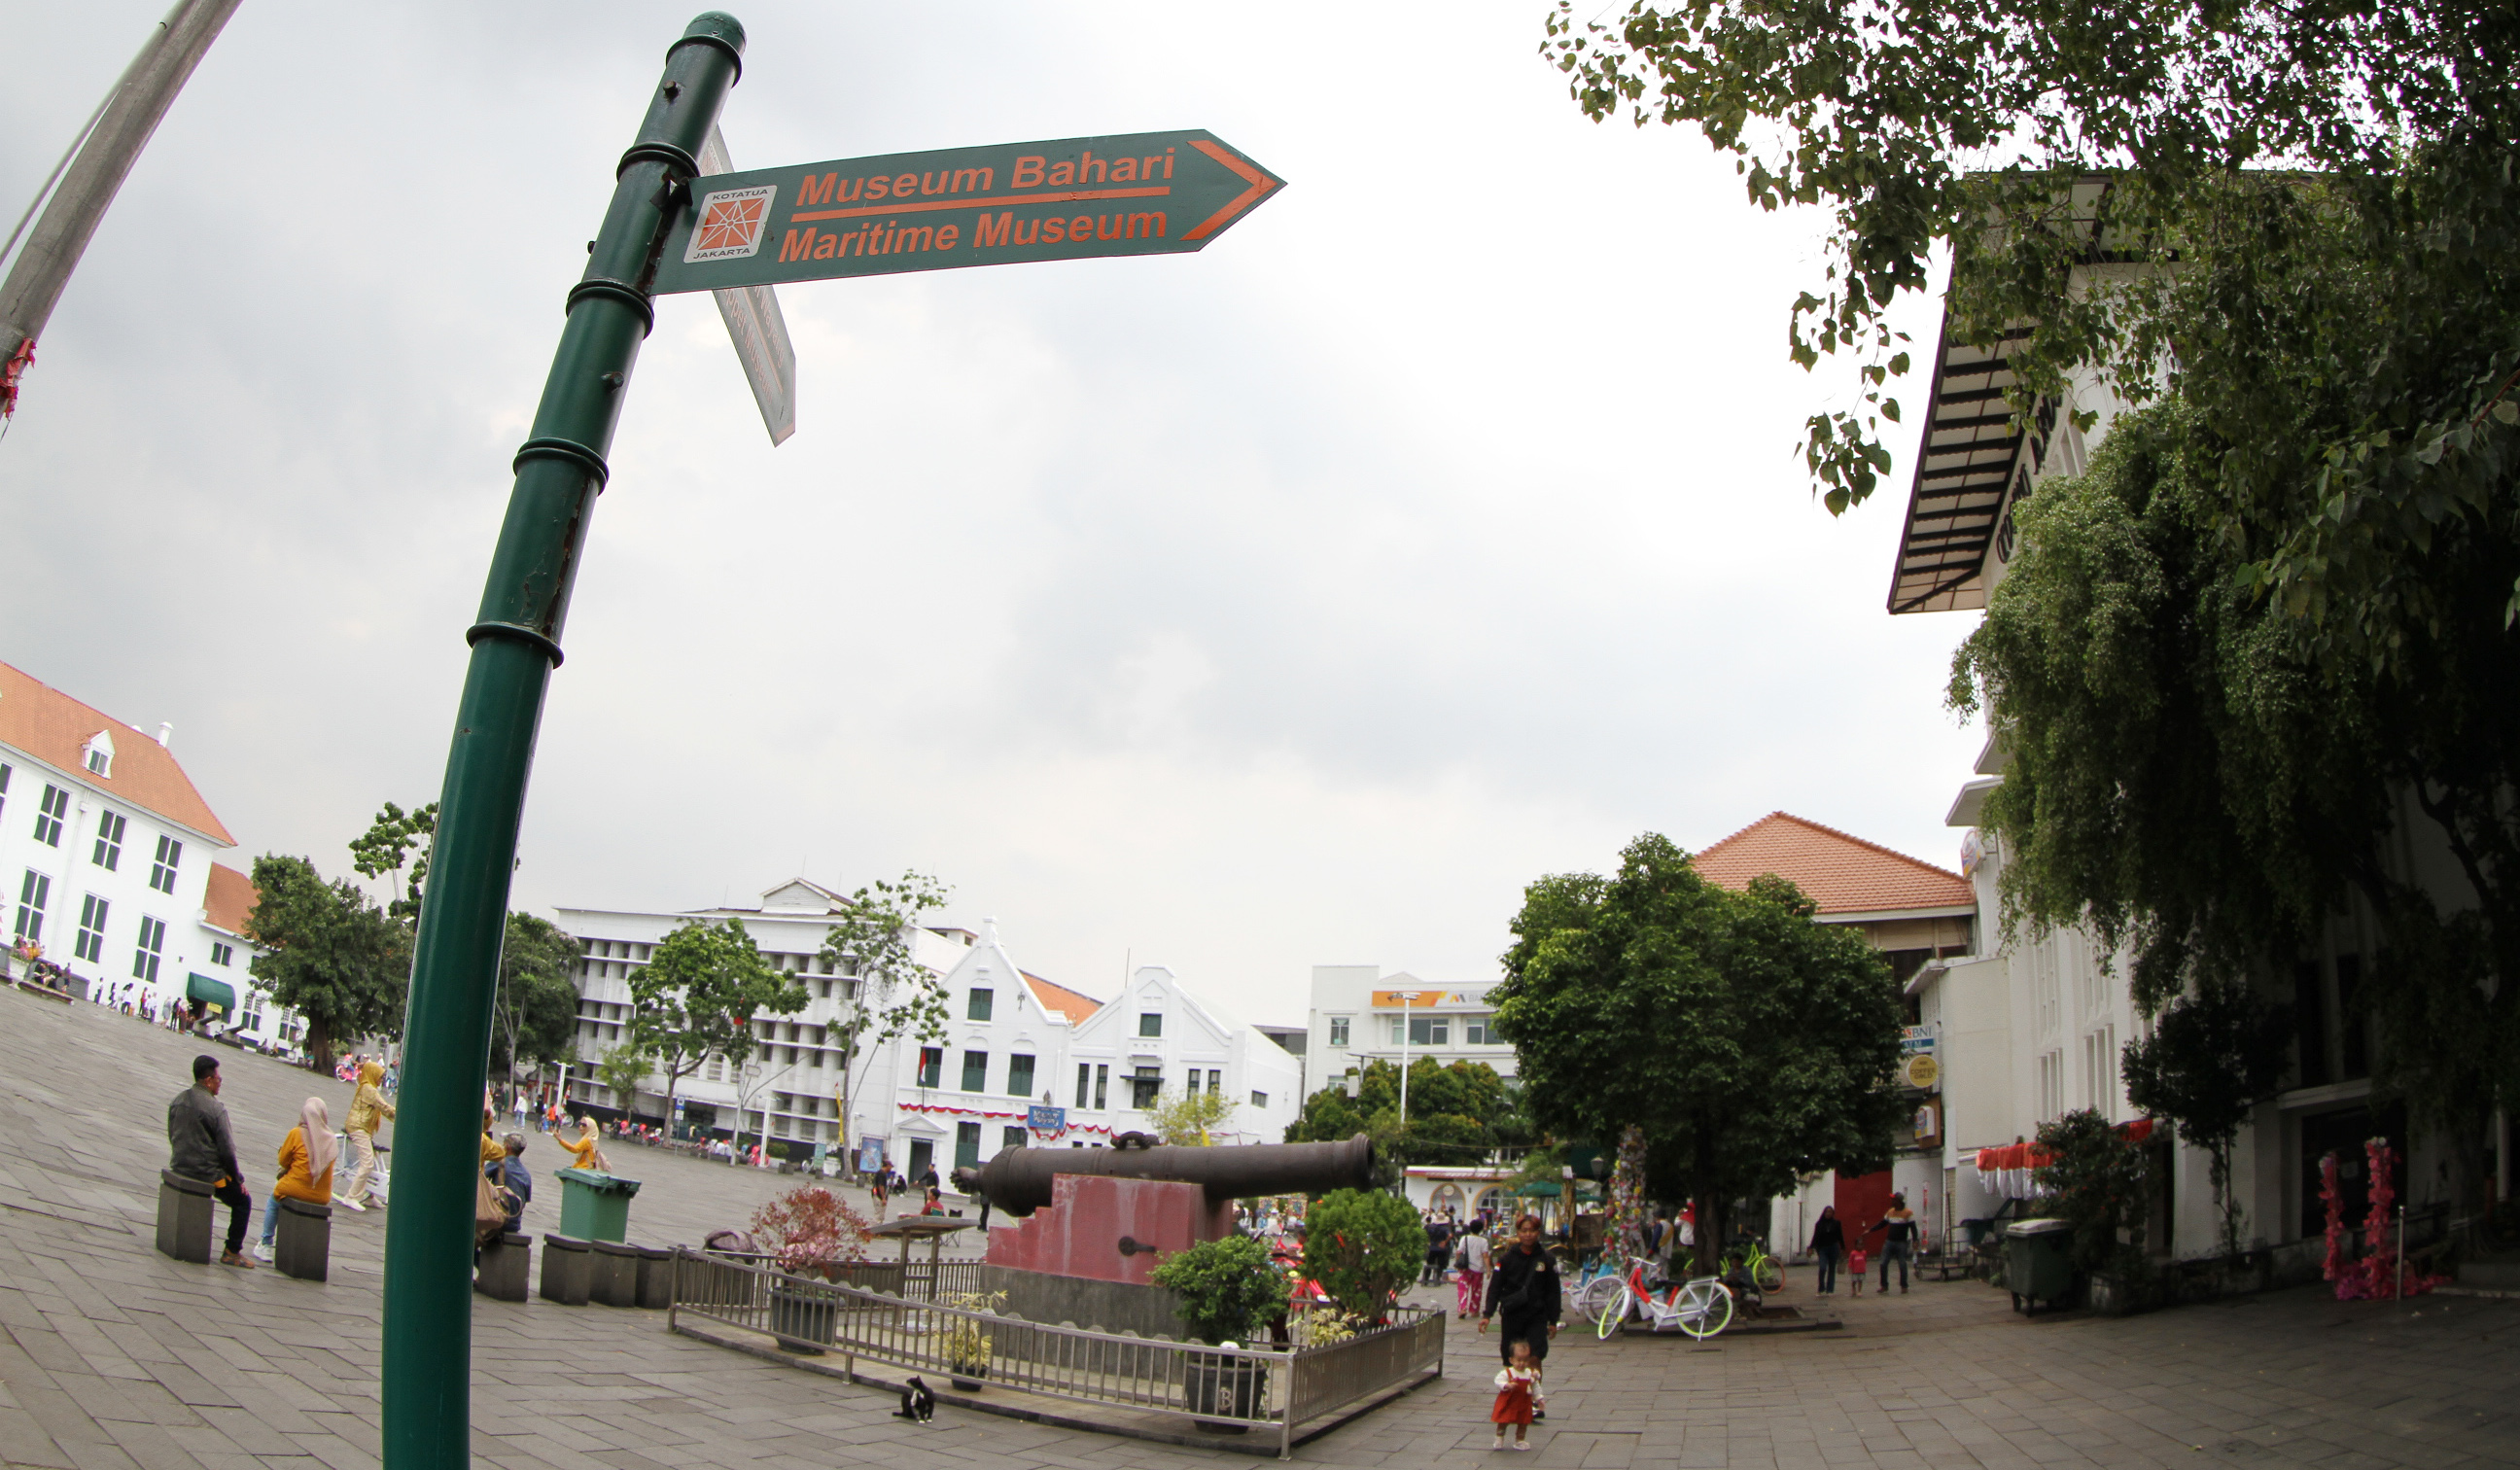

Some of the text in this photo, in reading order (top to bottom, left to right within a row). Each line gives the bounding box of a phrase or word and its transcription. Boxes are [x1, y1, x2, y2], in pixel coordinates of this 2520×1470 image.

[795, 147, 1175, 207] Museum Bahari
[712, 189, 768, 201] KOTATUA
[778, 211, 1167, 263] Maritime Museum
[693, 247, 751, 260] JAKARTA
[744, 323, 774, 406] Museum
[1912, 1026, 1932, 1038] BNI
